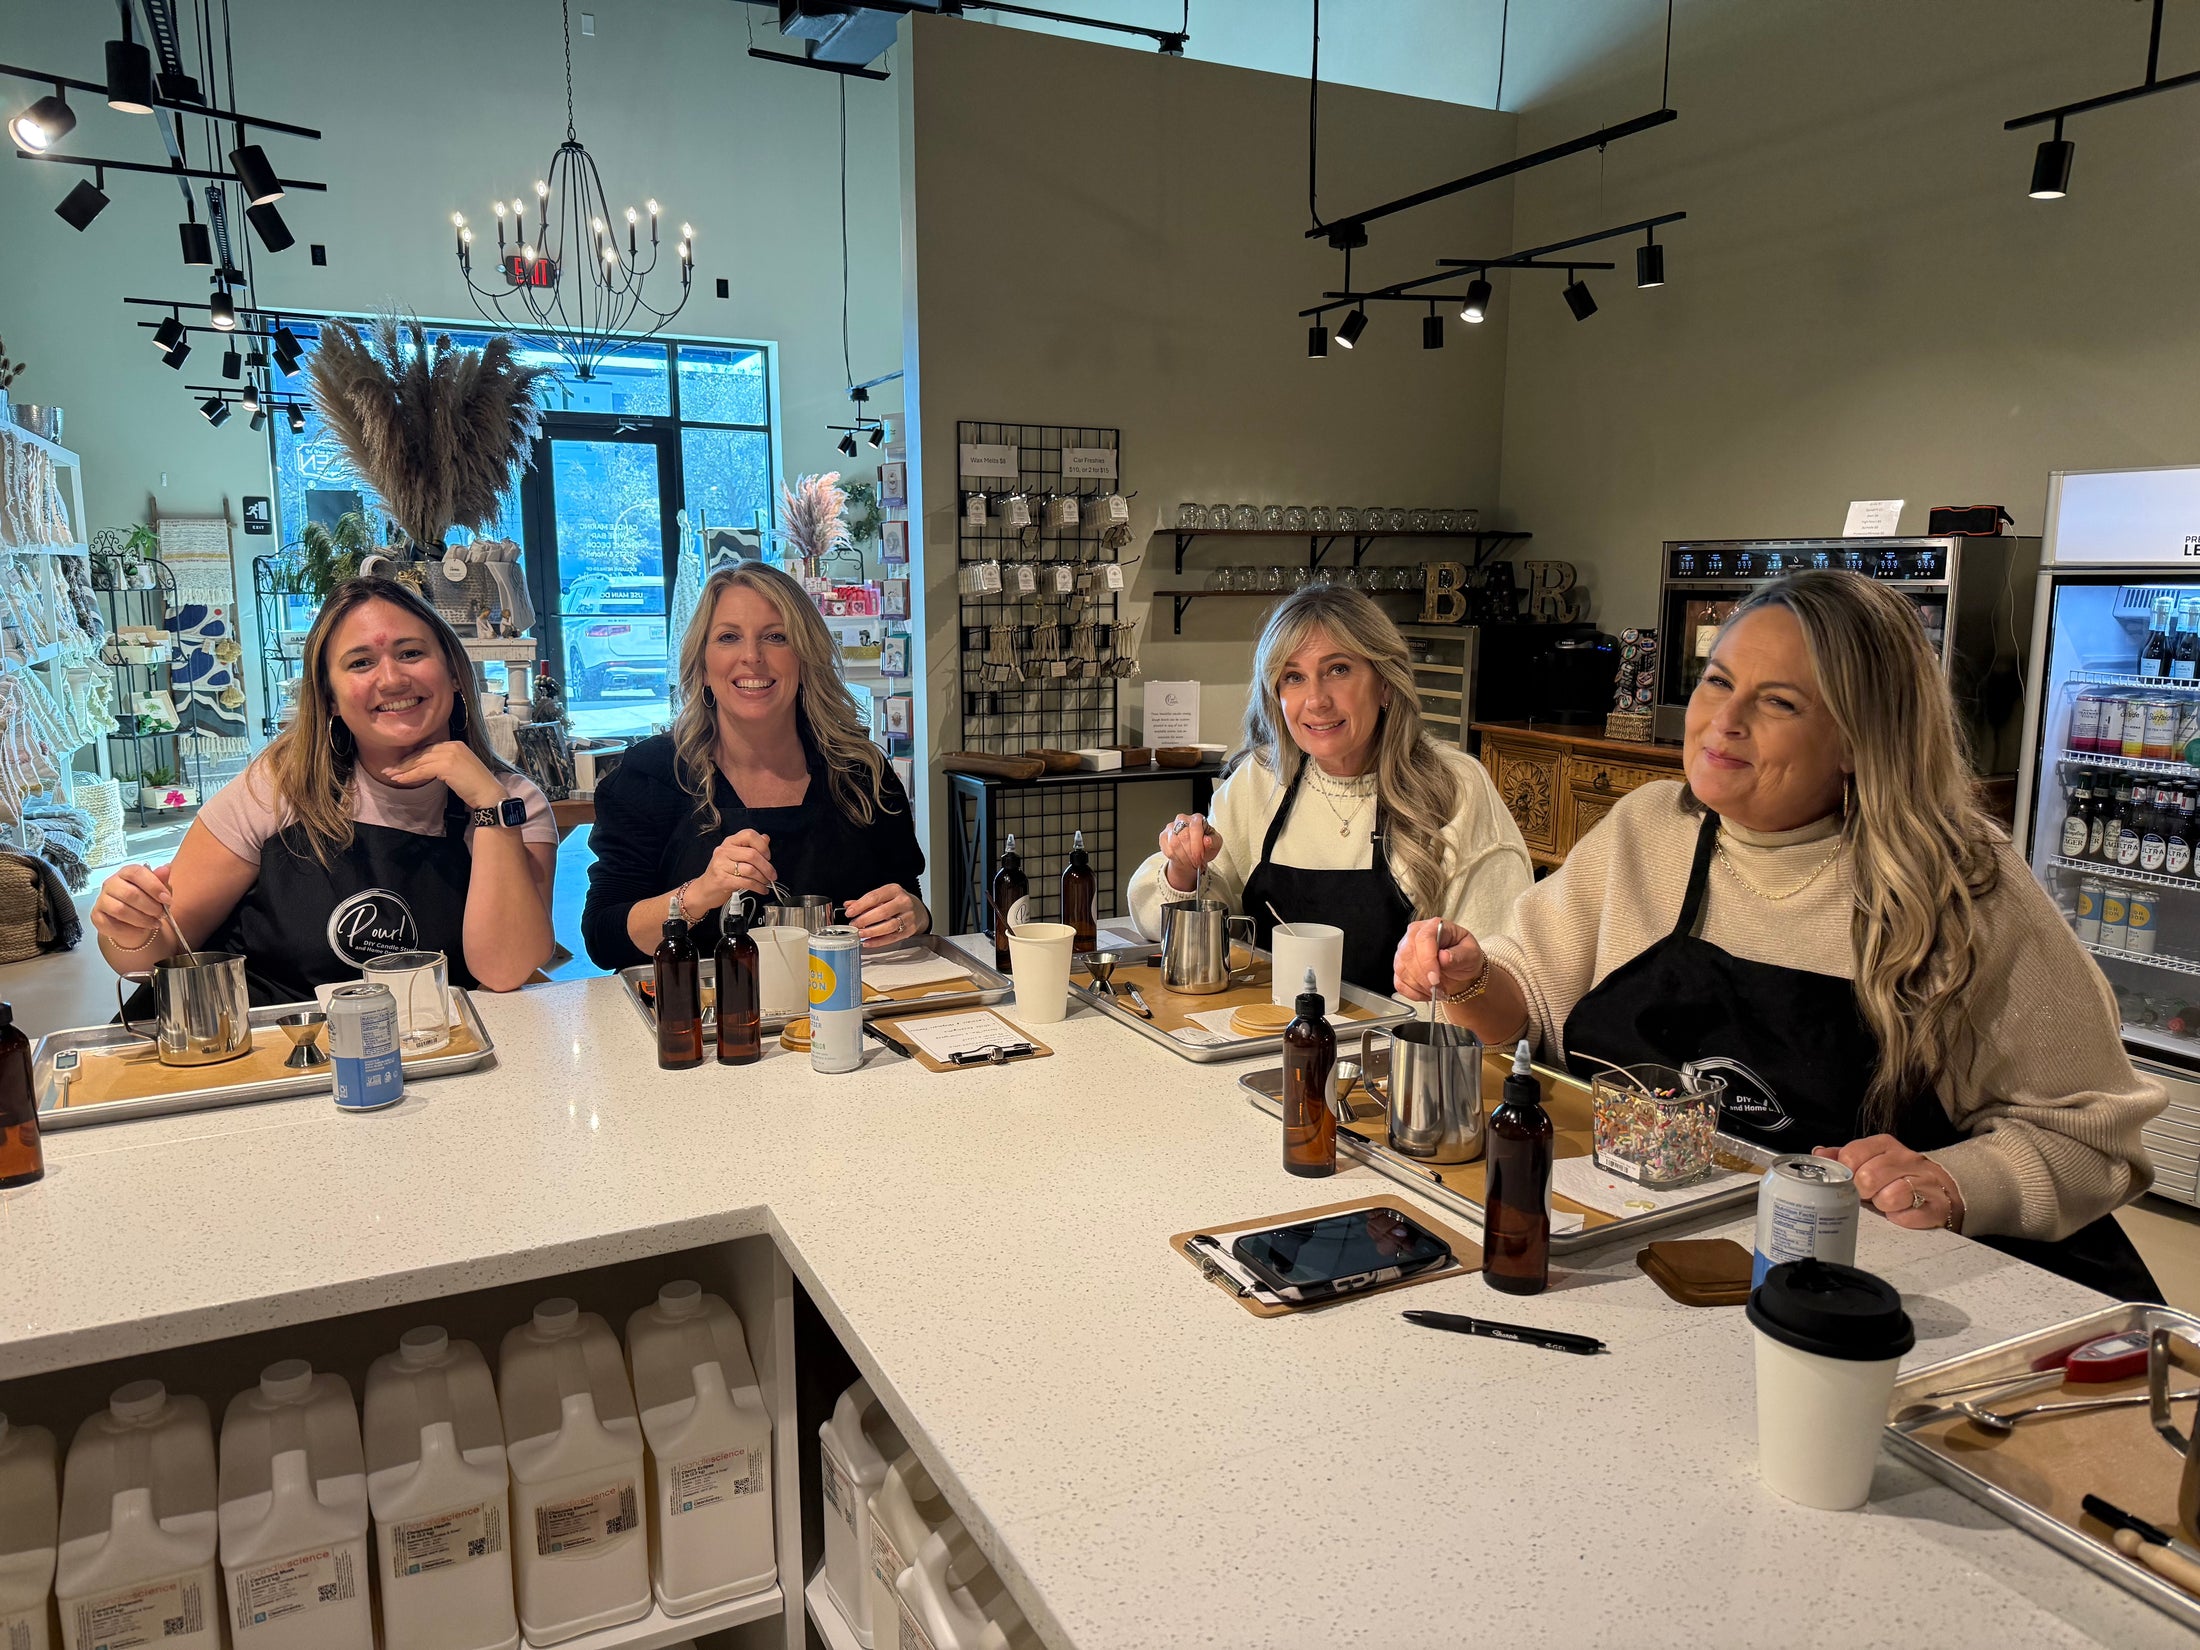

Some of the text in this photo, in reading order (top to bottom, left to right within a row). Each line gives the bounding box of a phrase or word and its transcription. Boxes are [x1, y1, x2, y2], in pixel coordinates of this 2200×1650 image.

[1417, 561, 1581, 624] BAR
[2120, 843, 2139, 851] LTRA
[337, 903, 406, 948] Pour!
[376, 942, 399, 951] Candle
[1736, 1095, 1751, 1103] DIY
[1492, 1329, 1520, 1340] Sharpie
[681, 1449, 745, 1470] candlescience
